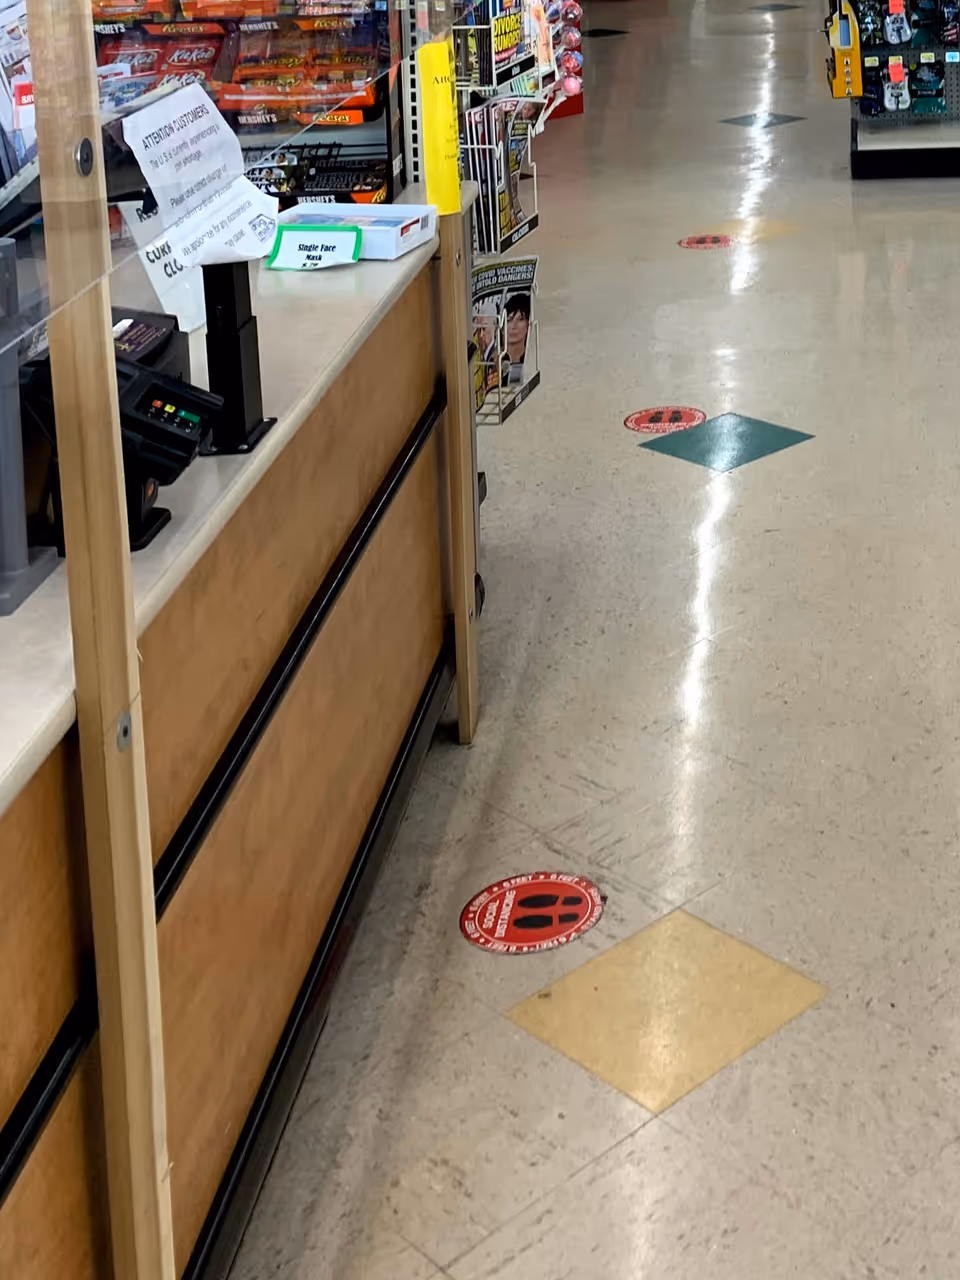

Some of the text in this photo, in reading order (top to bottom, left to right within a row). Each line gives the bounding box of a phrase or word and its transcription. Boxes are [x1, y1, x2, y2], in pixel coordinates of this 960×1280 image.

[162, 23, 204, 33] Reese's
[237, 114, 277, 124] HERSHEY'S
[142, 104, 210, 151] ATTENTION CUSTOMERS
[297, 243, 337, 252] Single Face
[305, 254, 323, 262] Mask
